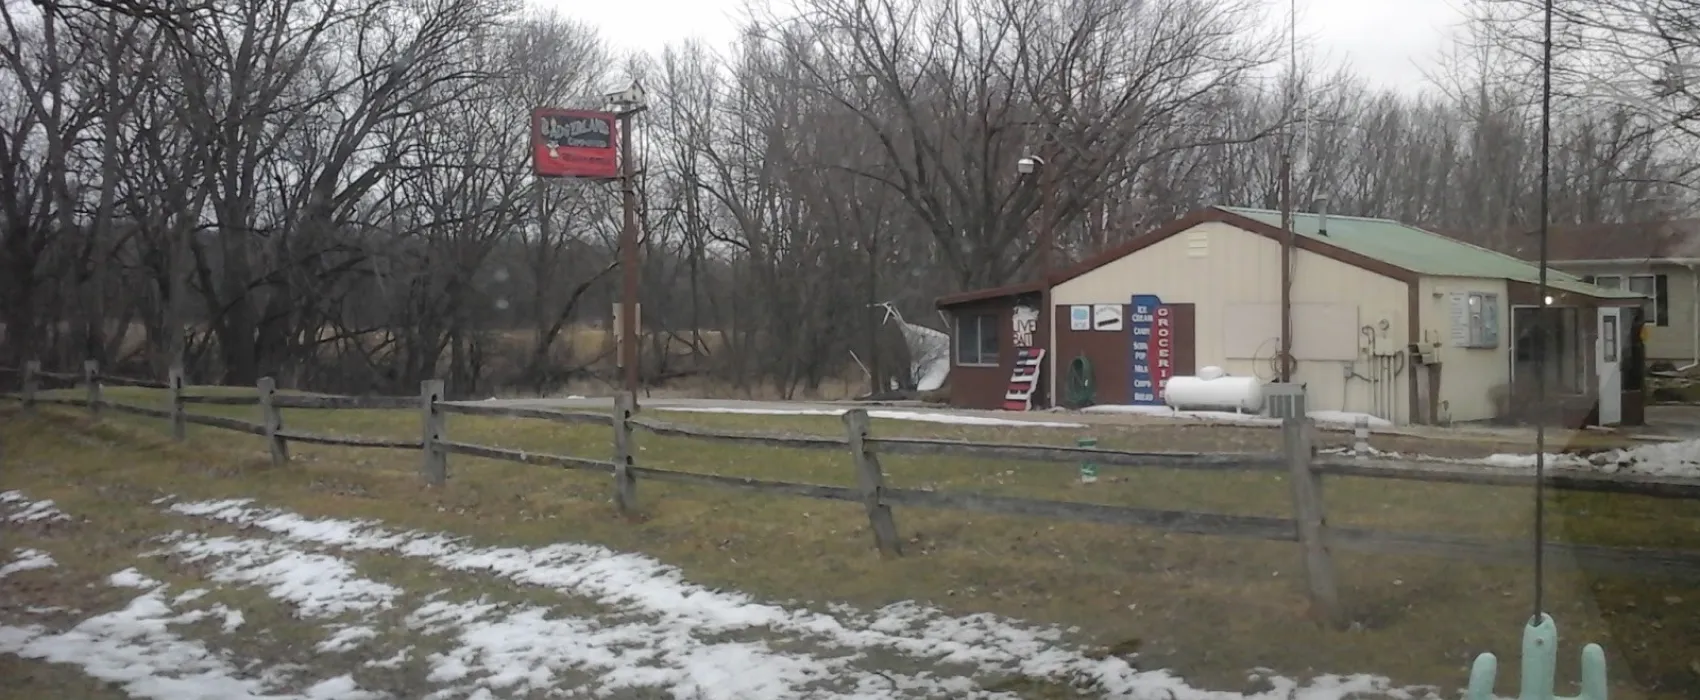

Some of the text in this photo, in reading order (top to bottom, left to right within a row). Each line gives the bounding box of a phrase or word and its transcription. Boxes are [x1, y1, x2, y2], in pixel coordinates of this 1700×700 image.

[1012, 317, 1036, 332] LIVE
[1013, 332, 1033, 347] BAIT
[1135, 351, 1147, 360] POP
